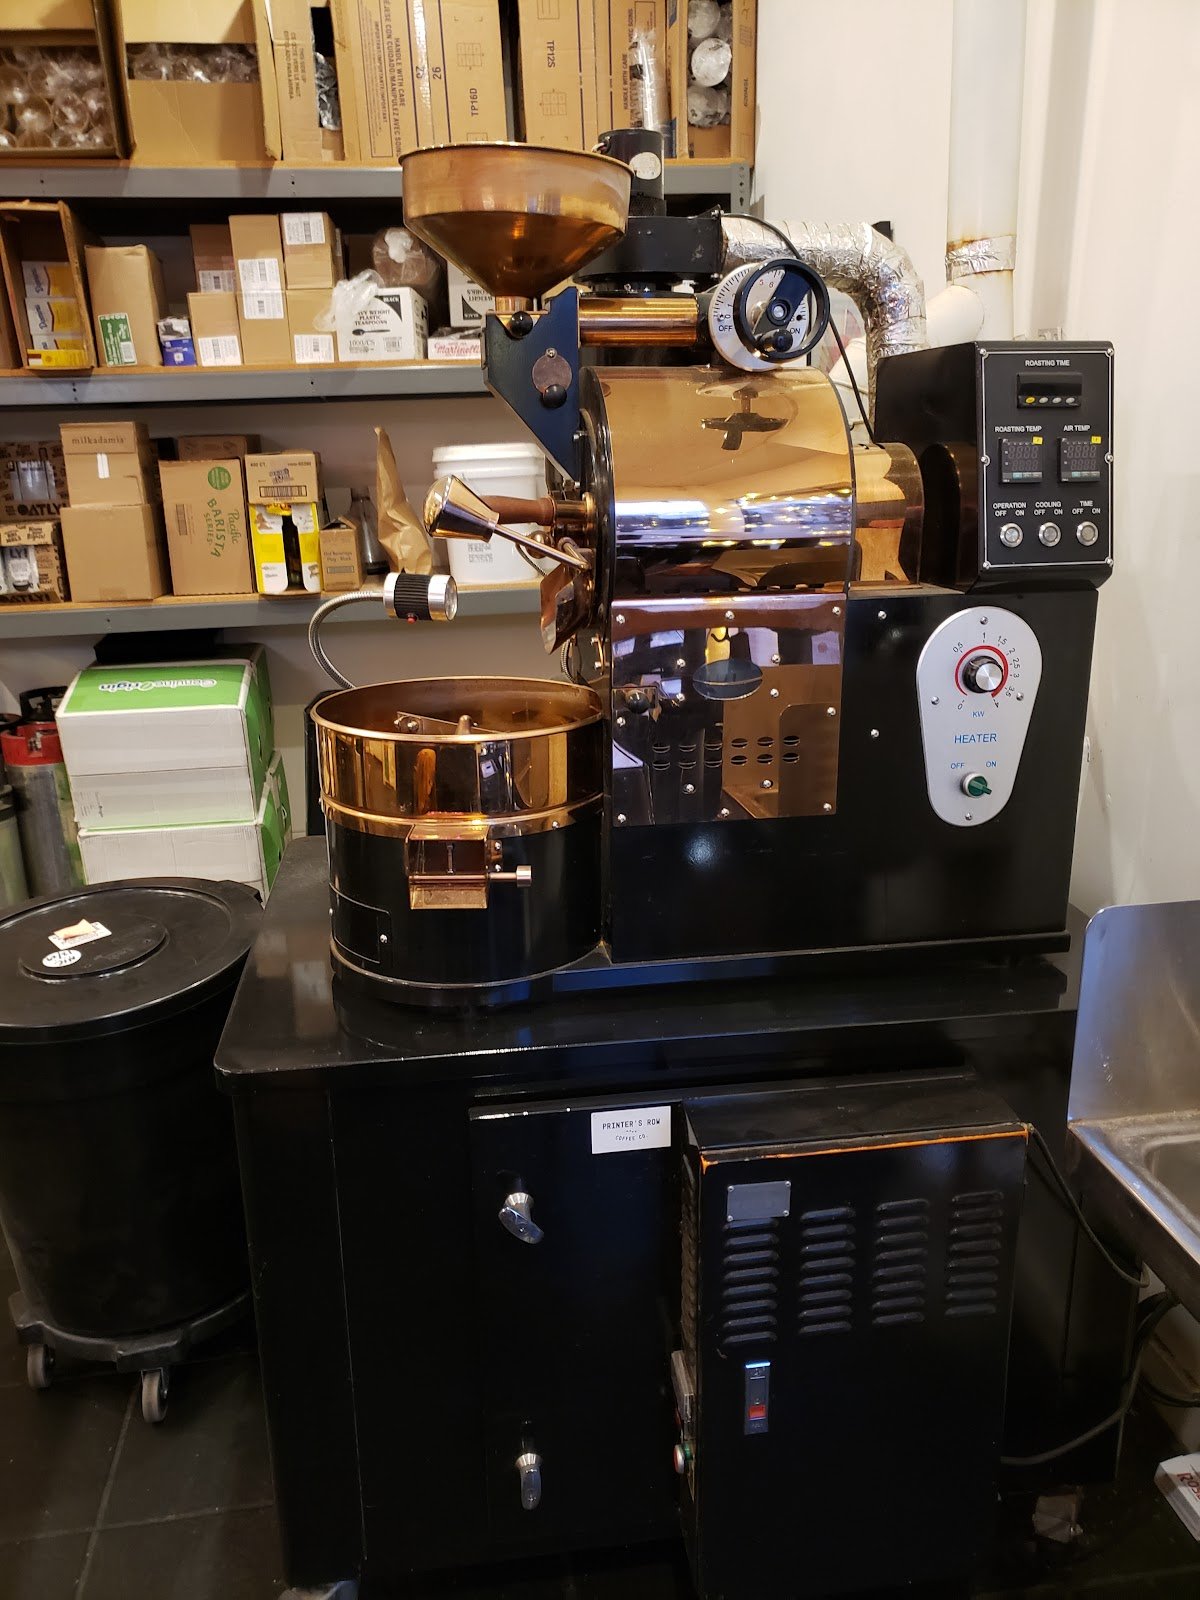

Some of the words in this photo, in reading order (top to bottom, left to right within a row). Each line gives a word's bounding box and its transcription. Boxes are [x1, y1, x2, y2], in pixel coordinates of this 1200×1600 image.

[394, 38, 402, 66] HANDLE
[546, 40, 556, 68] TP12S
[385, 24, 393, 39] CON
[393, 118, 401, 136] AVEC
[396, 69, 404, 87] WITH
[432, 66, 442, 80] 26
[398, 89, 406, 107] CARE
[469, 87, 479, 117] TP16D
[718, 324, 733, 332] OFF
[71, 435, 125, 445] milkadamia
[204, 513, 214, 543] SERIES
[207, 498, 226, 558] BARISTA
[228, 509, 242, 545] Pacific
[952, 642, 963, 653] 0.5
[998, 635, 1008, 645] 1.5
[954, 733, 997, 743] HEATER
[602, 1119, 643, 1130] PRINTER'S
[647, 1118, 661, 1126] ROW
